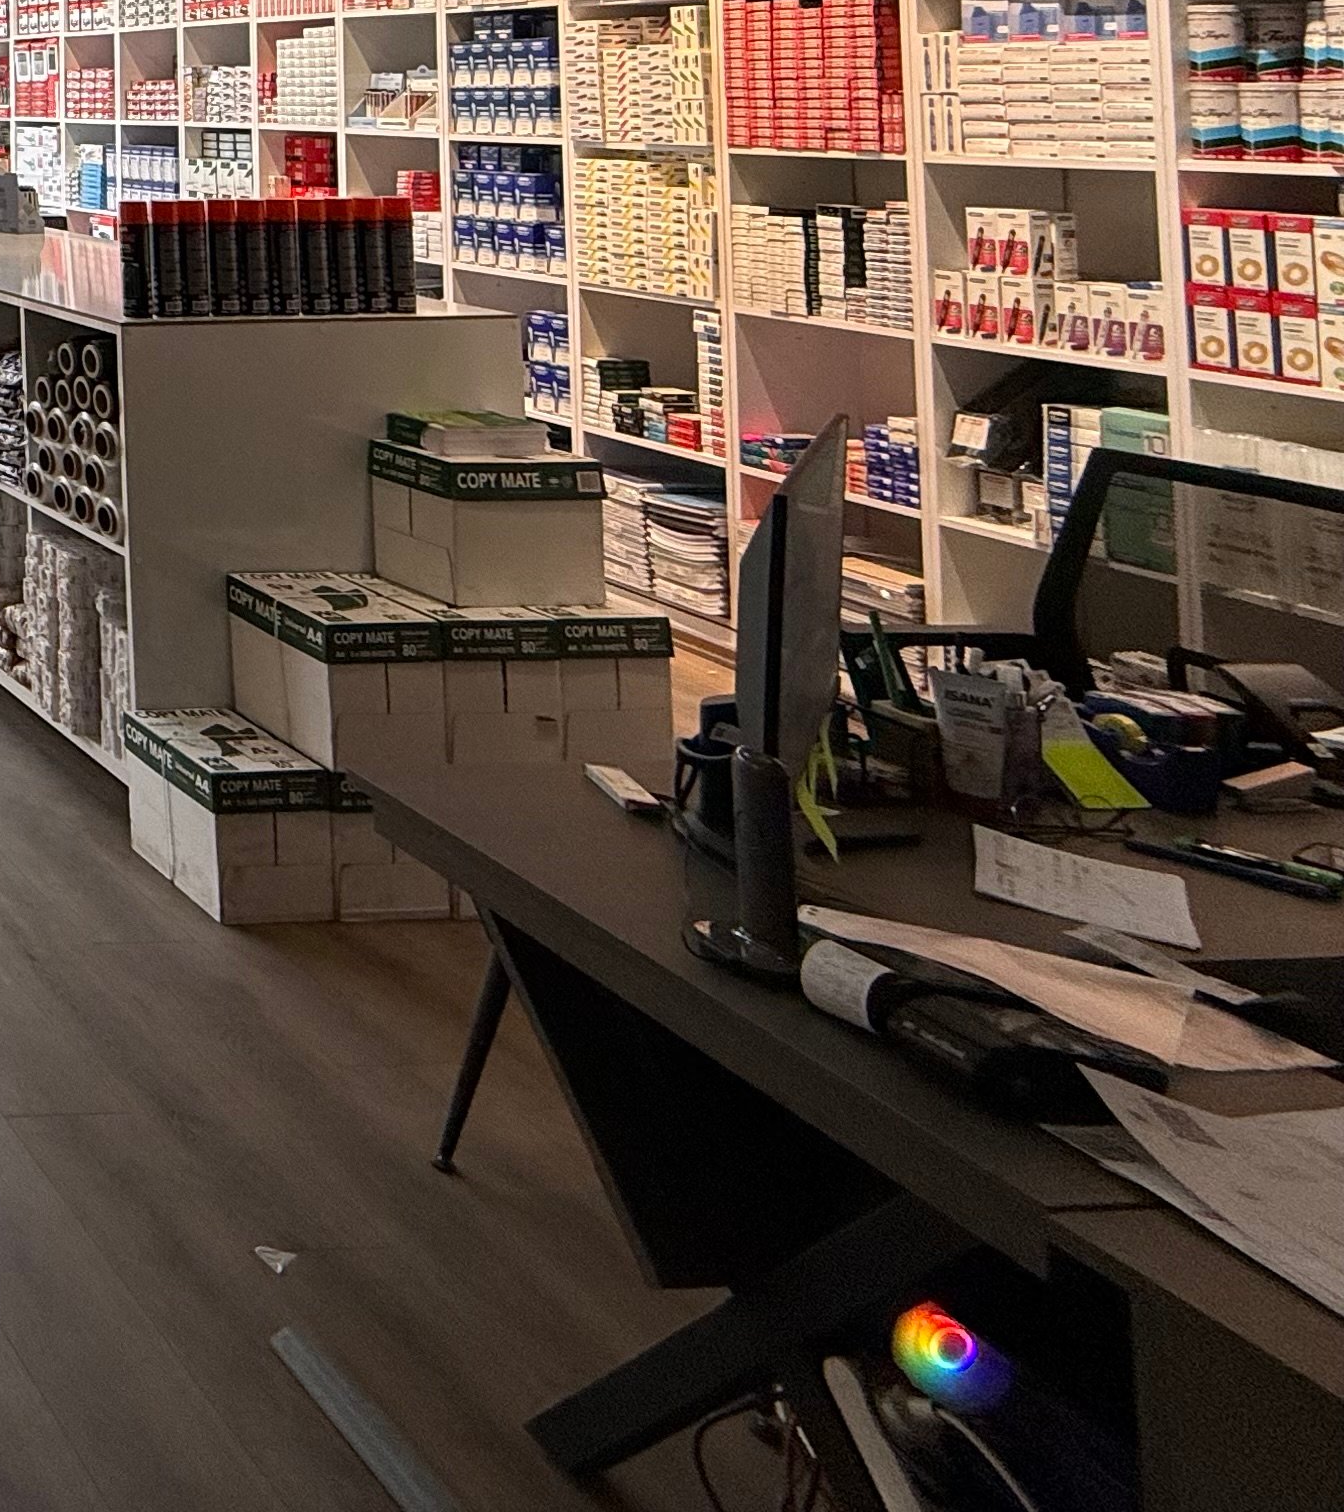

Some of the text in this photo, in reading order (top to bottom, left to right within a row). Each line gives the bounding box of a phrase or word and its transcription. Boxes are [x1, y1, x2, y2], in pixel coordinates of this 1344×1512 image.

[373, 447, 417, 470] COPY MATE
[457, 472, 541, 489] COPY MATE
[229, 585, 254, 610] COPY
[255, 598, 282, 627] MATE
[306, 627, 323, 646] A4
[333, 631, 396, 645] COPY MATE
[451, 628, 514, 640] COPY MATE
[564, 624, 627, 638] COPY MATE
[402, 644, 417, 657] 80
[521, 641, 535, 653] 80
[633, 638, 648, 650] 80
[135, 709, 231, 719] COPY MATE
[125, 723, 147, 748] COPY
[149, 739, 173, 770] MATE
[194, 772, 210, 793] A4
[220, 779, 282, 793] COPY MATE
[289, 791, 303, 804] 80
